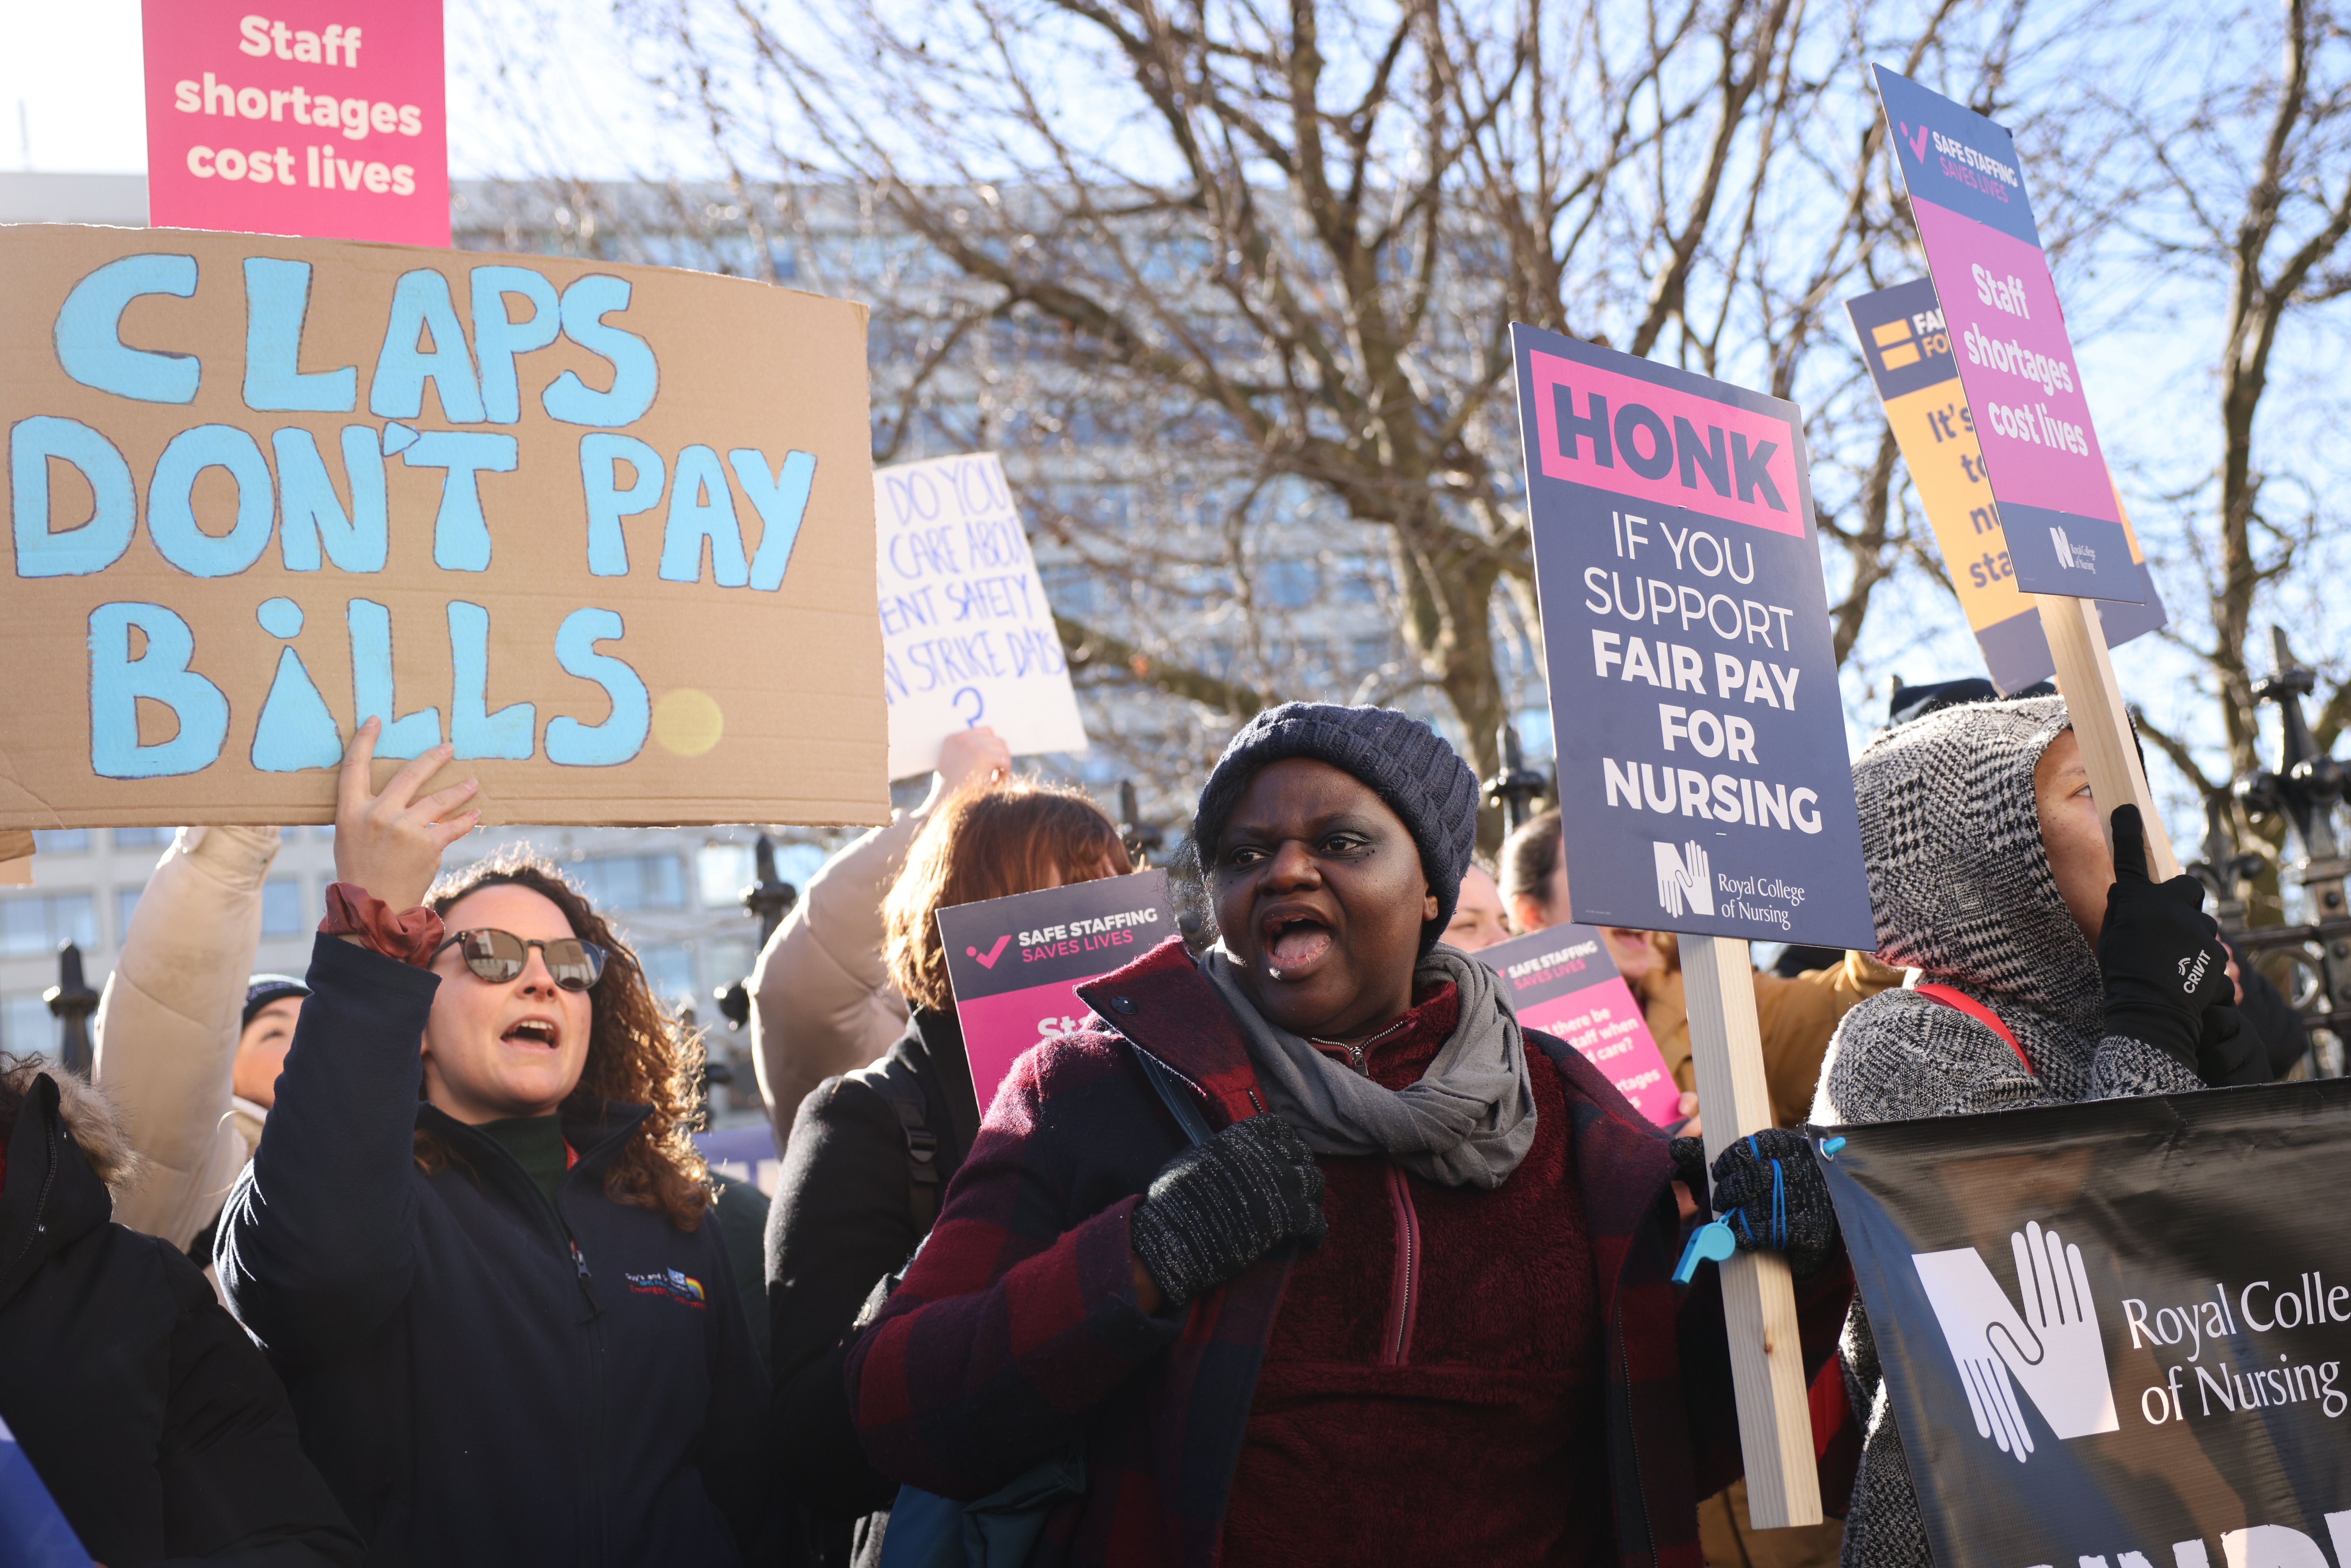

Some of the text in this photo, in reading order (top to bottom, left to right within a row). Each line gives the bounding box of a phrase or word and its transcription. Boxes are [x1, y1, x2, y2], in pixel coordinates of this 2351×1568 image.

[238, 16, 361, 68] Staff
[175, 72, 422, 140] shortages
[187, 146, 415, 196] cost lives
[1932, 131, 2018, 188] SAFE STAFFING
[1940, 156, 2009, 203] SAVES LIVES
[1972, 263, 2030, 320] Staff
[54, 253, 660, 427] CLAPS
[1912, 307, 1945, 335] FAI
[1921, 332, 1950, 358] FO
[1964, 322, 2074, 396] shortages
[1552, 382, 1789, 513] HONK
[1988, 401, 2088, 456] cost lives
[9, 415, 816, 592] DON'T PAY
[884, 459, 1009, 525] DO YOU
[890, 525, 961, 579] CARE
[1613, 511, 1754, 584] IF YOU
[1969, 551, 2014, 588] sta
[945, 573, 1033, 622] SAFETY
[1584, 566, 1793, 651] SUPPORT
[907, 631, 1006, 692] STRIKE
[1005, 626, 1067, 678] DAYS
[1592, 629, 1799, 711] FAIR PAY
[1659, 703, 1759, 764] FOR
[1603, 758, 1822, 834] NURSING
[1718, 874, 1805, 907] Royal College
[1722, 899, 1791, 931] of Nursing
[1019, 908, 1157, 946] SAFE STAFFING
[1022, 929, 1134, 963] SAVES LIVES
[1508, 940, 1598, 978] SAFE STAFFING
[1514, 958, 1587, 990] SAVES LIVES
[2183, 949, 2211, 993] CRIVIT
[1551, 1015, 1591, 1035] there
[1589, 1007, 1612, 1023] be
[1569, 1017, 1639, 1050] taff when
[1596, 1036, 1634, 1061] care?
[1615, 1068, 1661, 1092] rtages
[2122, 1271, 2351, 1362] Royal Colle
[2141, 1353, 2348, 1425] of Nursing
